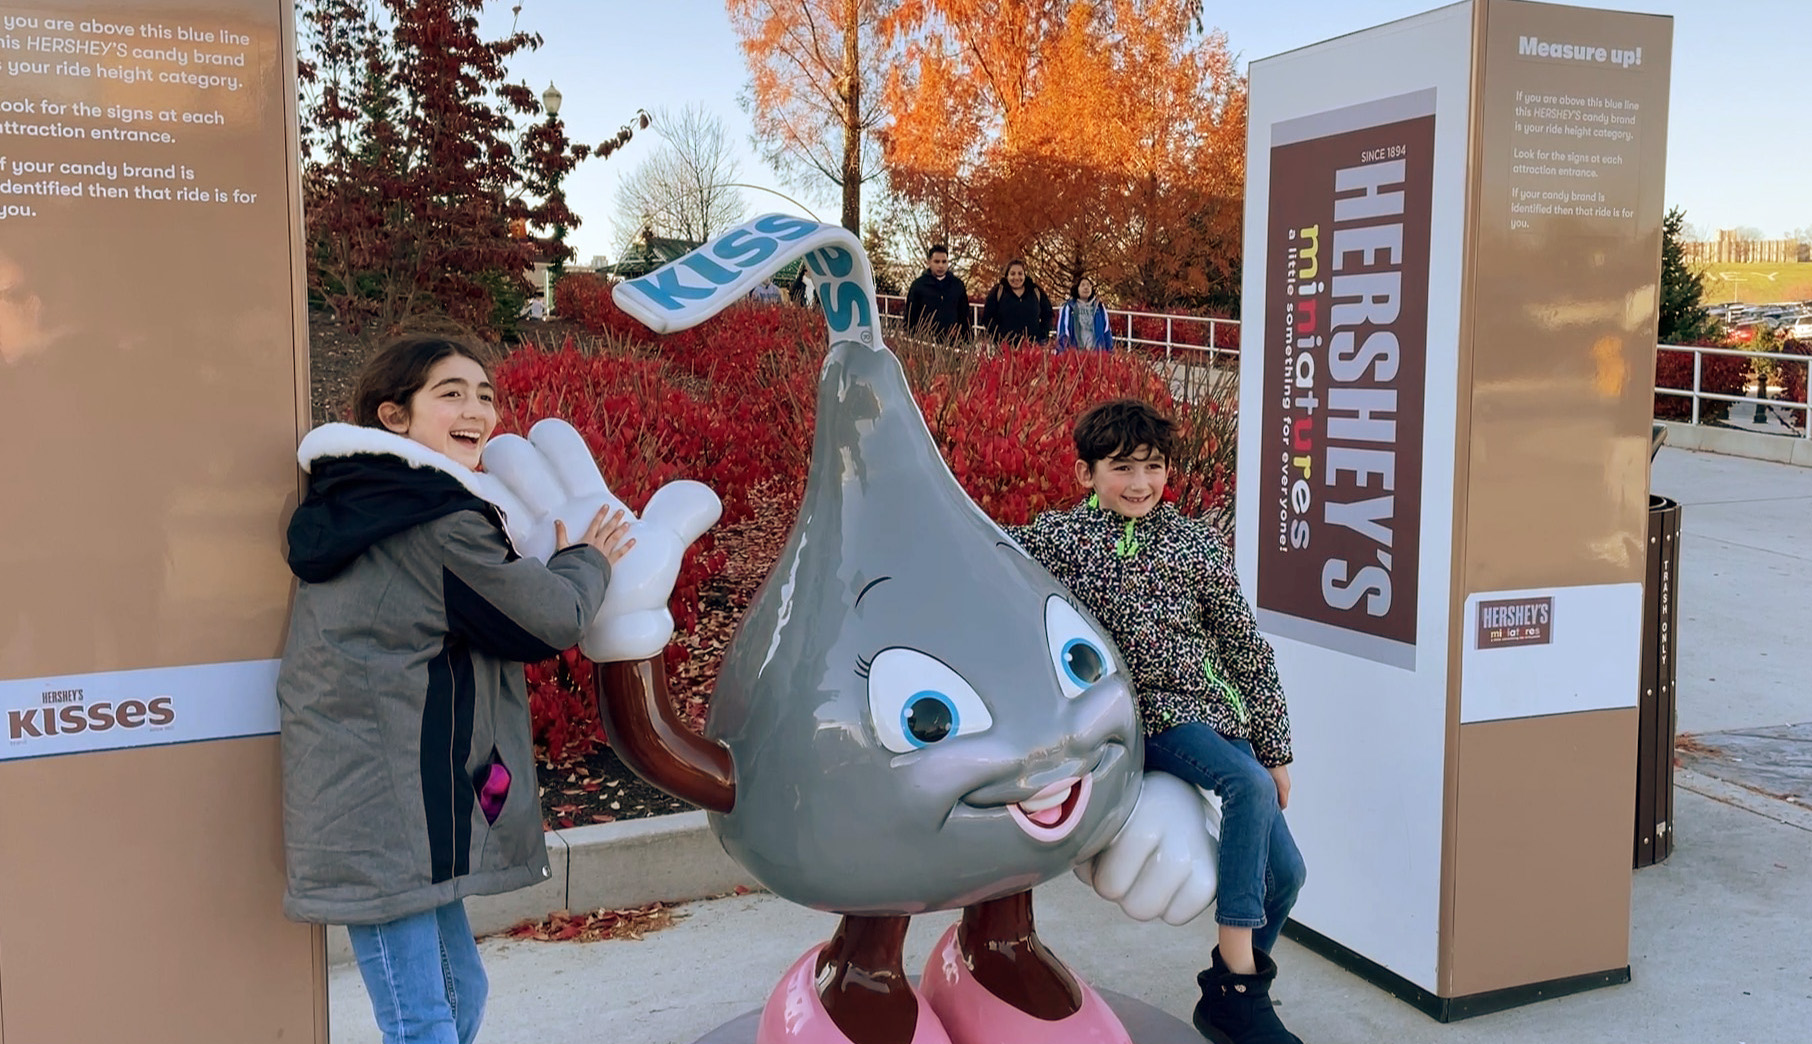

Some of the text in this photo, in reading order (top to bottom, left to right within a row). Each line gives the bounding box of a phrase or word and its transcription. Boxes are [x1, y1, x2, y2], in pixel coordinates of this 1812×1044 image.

[4, 15, 249, 46] you are above this blue line
[27, 36, 128, 57] HERSHEY'S
[133, 46, 187, 66] candy
[194, 50, 245, 66] brand
[1519, 36, 1642, 68] Measure up!
[8, 61, 50, 75] your
[56, 61, 91, 77] ride
[97, 64, 153, 83] height
[159, 70, 243, 90] category.
[1516, 90, 1639, 110] If you are above this blue line
[0, 98, 224, 125] ook for the signs at each
[1515, 106, 1636, 125] this HERSHEY'S candy brand
[91, 127, 176, 143] entrance.
[1515, 121, 1633, 141] is your ride height category.
[1361, 144, 1406, 163] SINCE 1894
[1513, 148, 1623, 165] Look for the signs at each
[12, 161, 54, 175] your
[60, 160, 117, 179] candy
[123, 163, 175, 179] brand
[180, 164, 195, 180] is
[1513, 164, 1598, 178] attraction entrance.
[88, 182, 128, 199] then
[134, 185, 171, 200] that
[176, 187, 209, 202] ride
[214, 189, 228, 202] is
[232, 189, 257, 203] for
[1512, 187, 1605, 203] If your candy brand is
[0, 204, 37, 218] you.
[1511, 203, 1634, 218] identified then that ride is for
[1511, 219, 1529, 230] you.
[1279, 228, 1297, 553] a little something for everyone!
[1290, 224, 1325, 550] miniatures
[1321, 158, 1406, 617] HERSHEY'S
[1483, 603, 1549, 629] HERSHEY'S
[42, 689, 84, 704] HERSHEY'S
